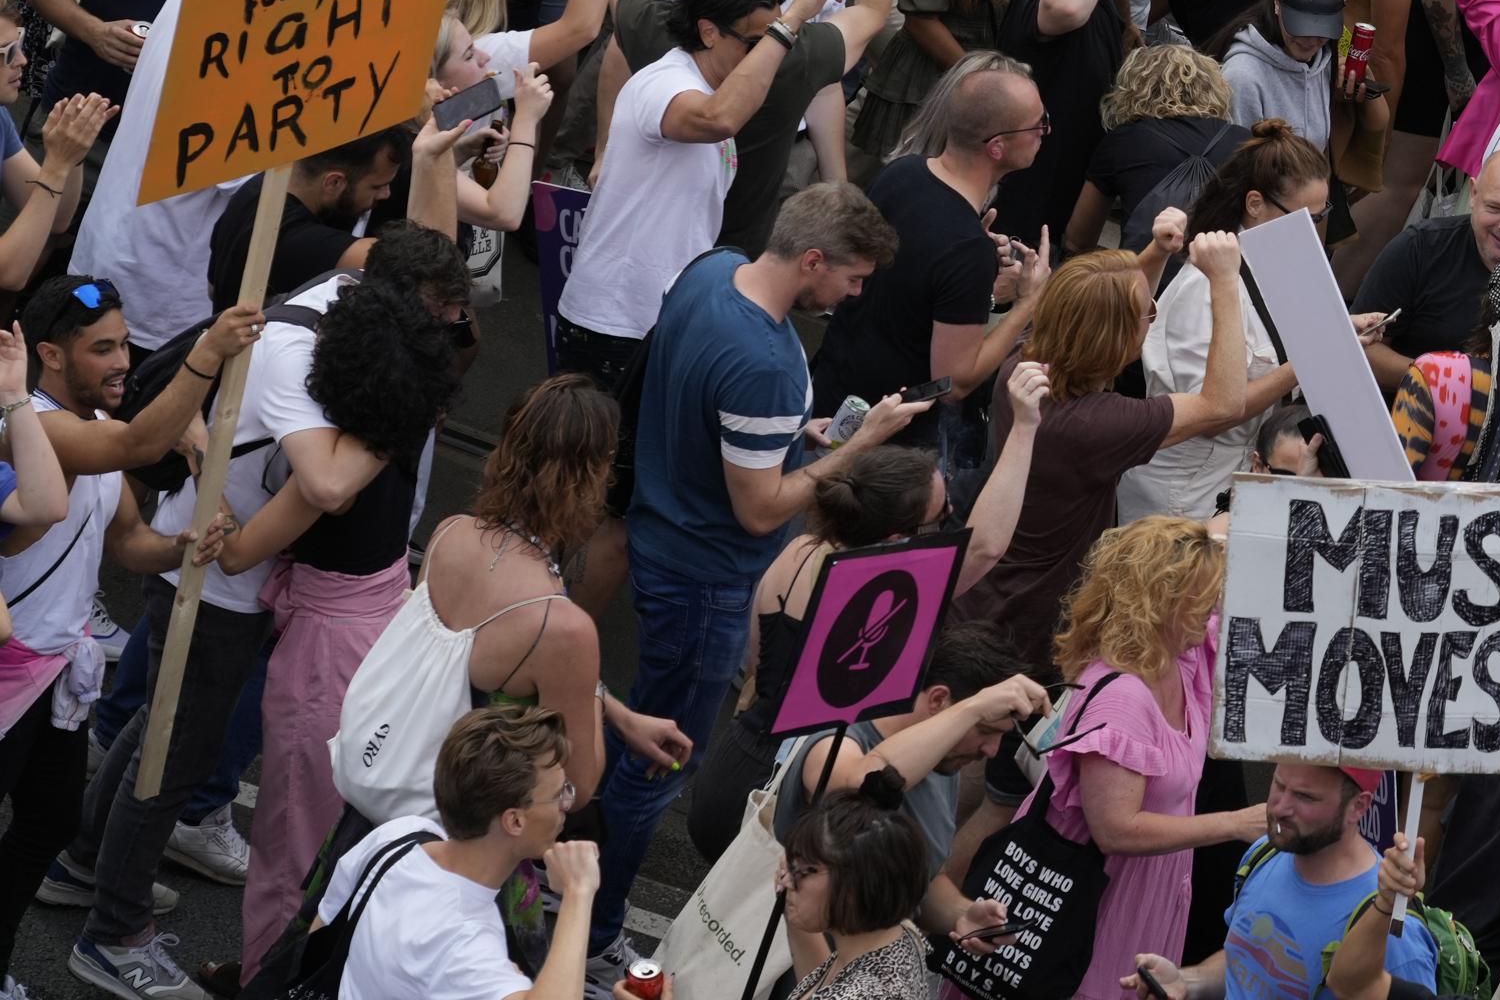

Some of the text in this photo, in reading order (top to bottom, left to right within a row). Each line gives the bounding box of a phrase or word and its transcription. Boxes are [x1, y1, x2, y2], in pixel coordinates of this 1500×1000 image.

[272, 55, 333, 94] TO
[176, 50, 400, 189] PARTY
[363, 724, 390, 767] SYRO
[993, 859, 1063, 912] LOVE GIRLS
[1004, 841, 1074, 893] BOYS WHO
[984, 877, 1054, 932] WHO LOVE
[984, 957, 1023, 989] LOVE
